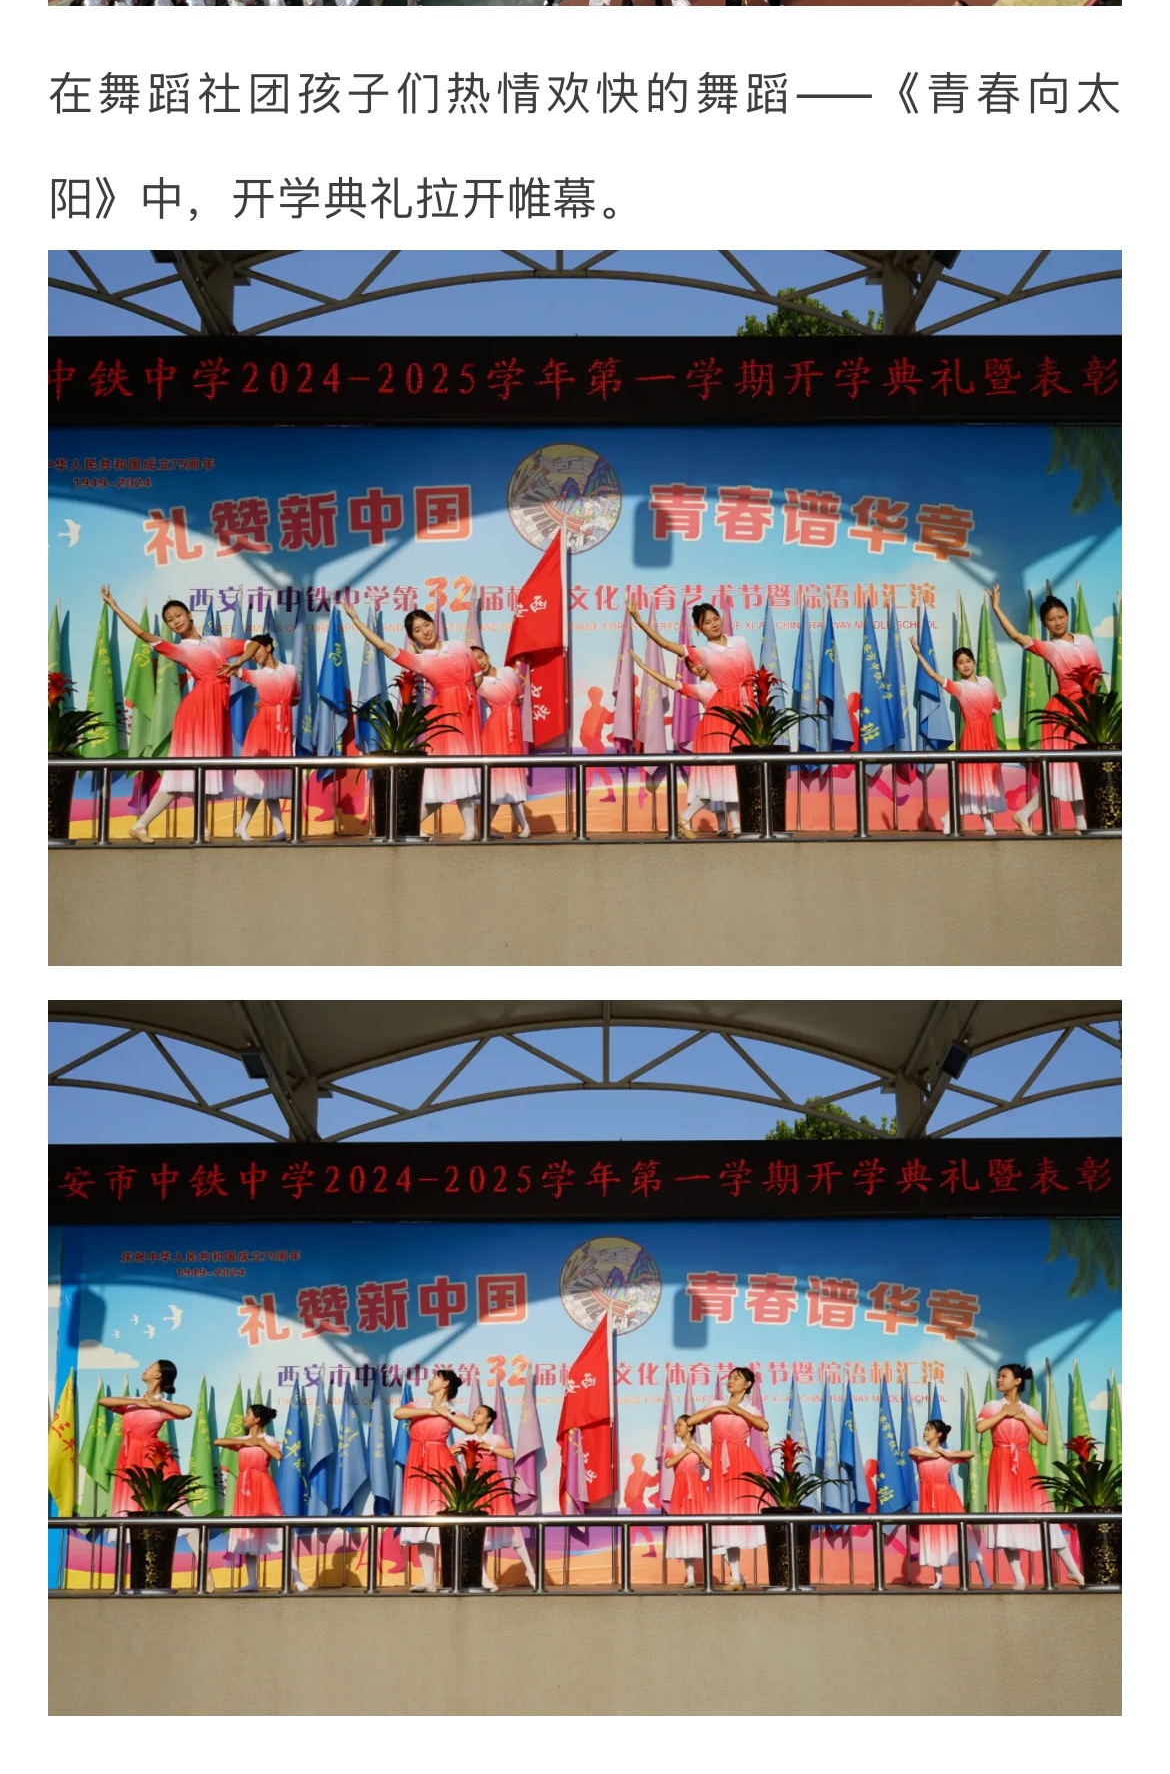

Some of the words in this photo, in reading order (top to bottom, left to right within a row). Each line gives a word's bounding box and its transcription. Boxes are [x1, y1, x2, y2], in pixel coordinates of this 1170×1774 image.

[51, 177, 626, 221] 阳》中，开学典礼拉开帷幕。
[48, 356, 1119, 400] 中铁中学2024-2025学年第一学期开学典礼暨表彰
[73, 477, 152, 489] 1949-2024
[143, 484, 473, 567] 礼赞新中国
[649, 482, 976, 561] 青春谱华章
[58, 1156, 1112, 1202] 安市中铁中学2024-2025学年第一学期开学典礼暨表彰
[238, 1274, 529, 1347] 礼赞新中国
[685, 1270, 982, 1345] 青春谱华章
